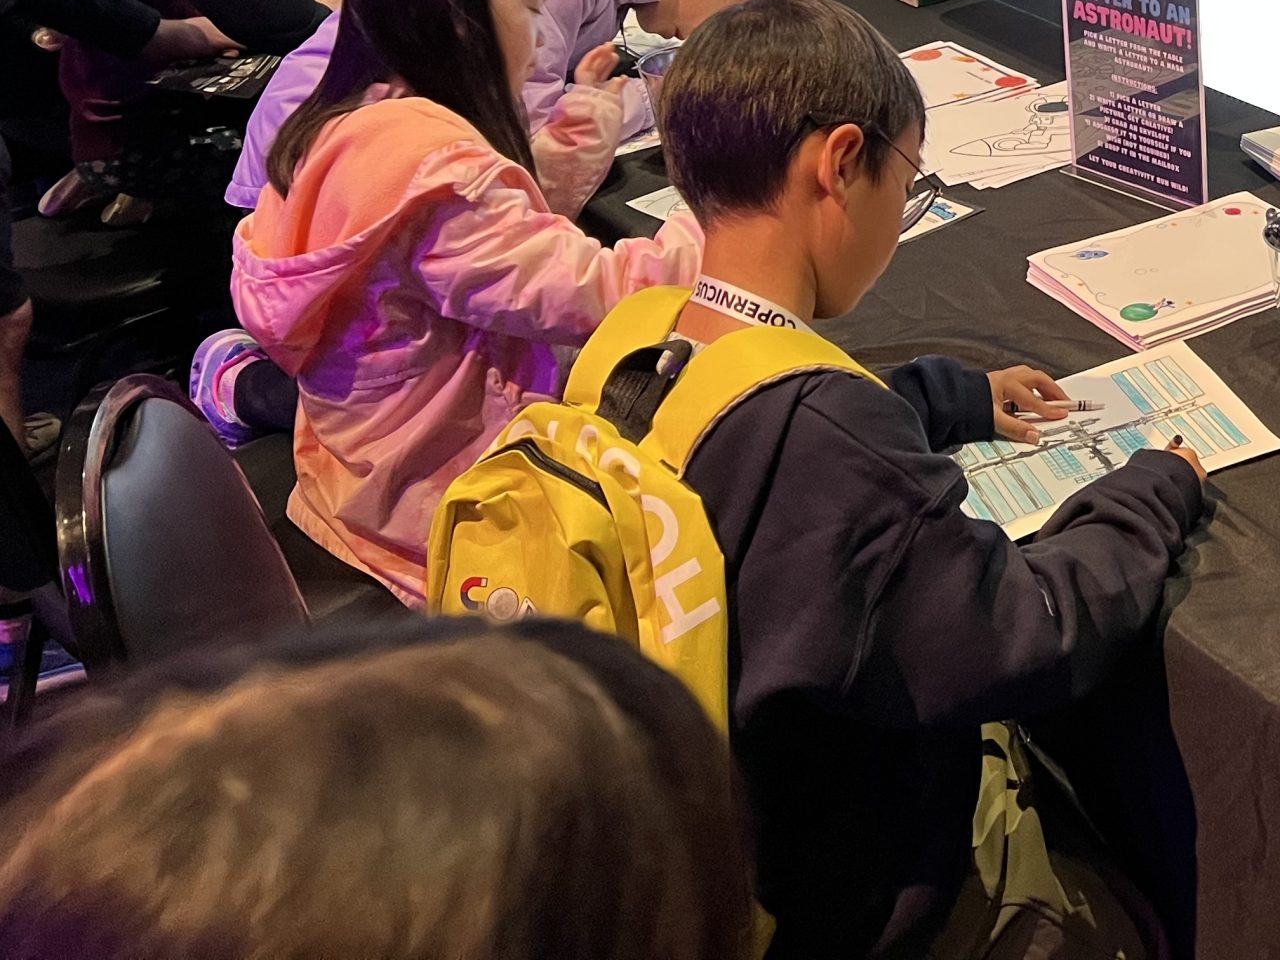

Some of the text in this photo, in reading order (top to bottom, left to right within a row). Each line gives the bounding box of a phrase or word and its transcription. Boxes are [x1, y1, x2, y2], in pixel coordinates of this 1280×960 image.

[1073, 0, 1192, 50] ASTRONAUT!
[1166, 3, 1190, 25] AN
[1083, 30, 1097, 39] PICK
[1105, 35, 1128, 47] LETTER
[1162, 51, 1183, 64] TABLE
[1125, 50, 1148, 63] LETTER
[1138, 98, 1161, 112] LETTER
